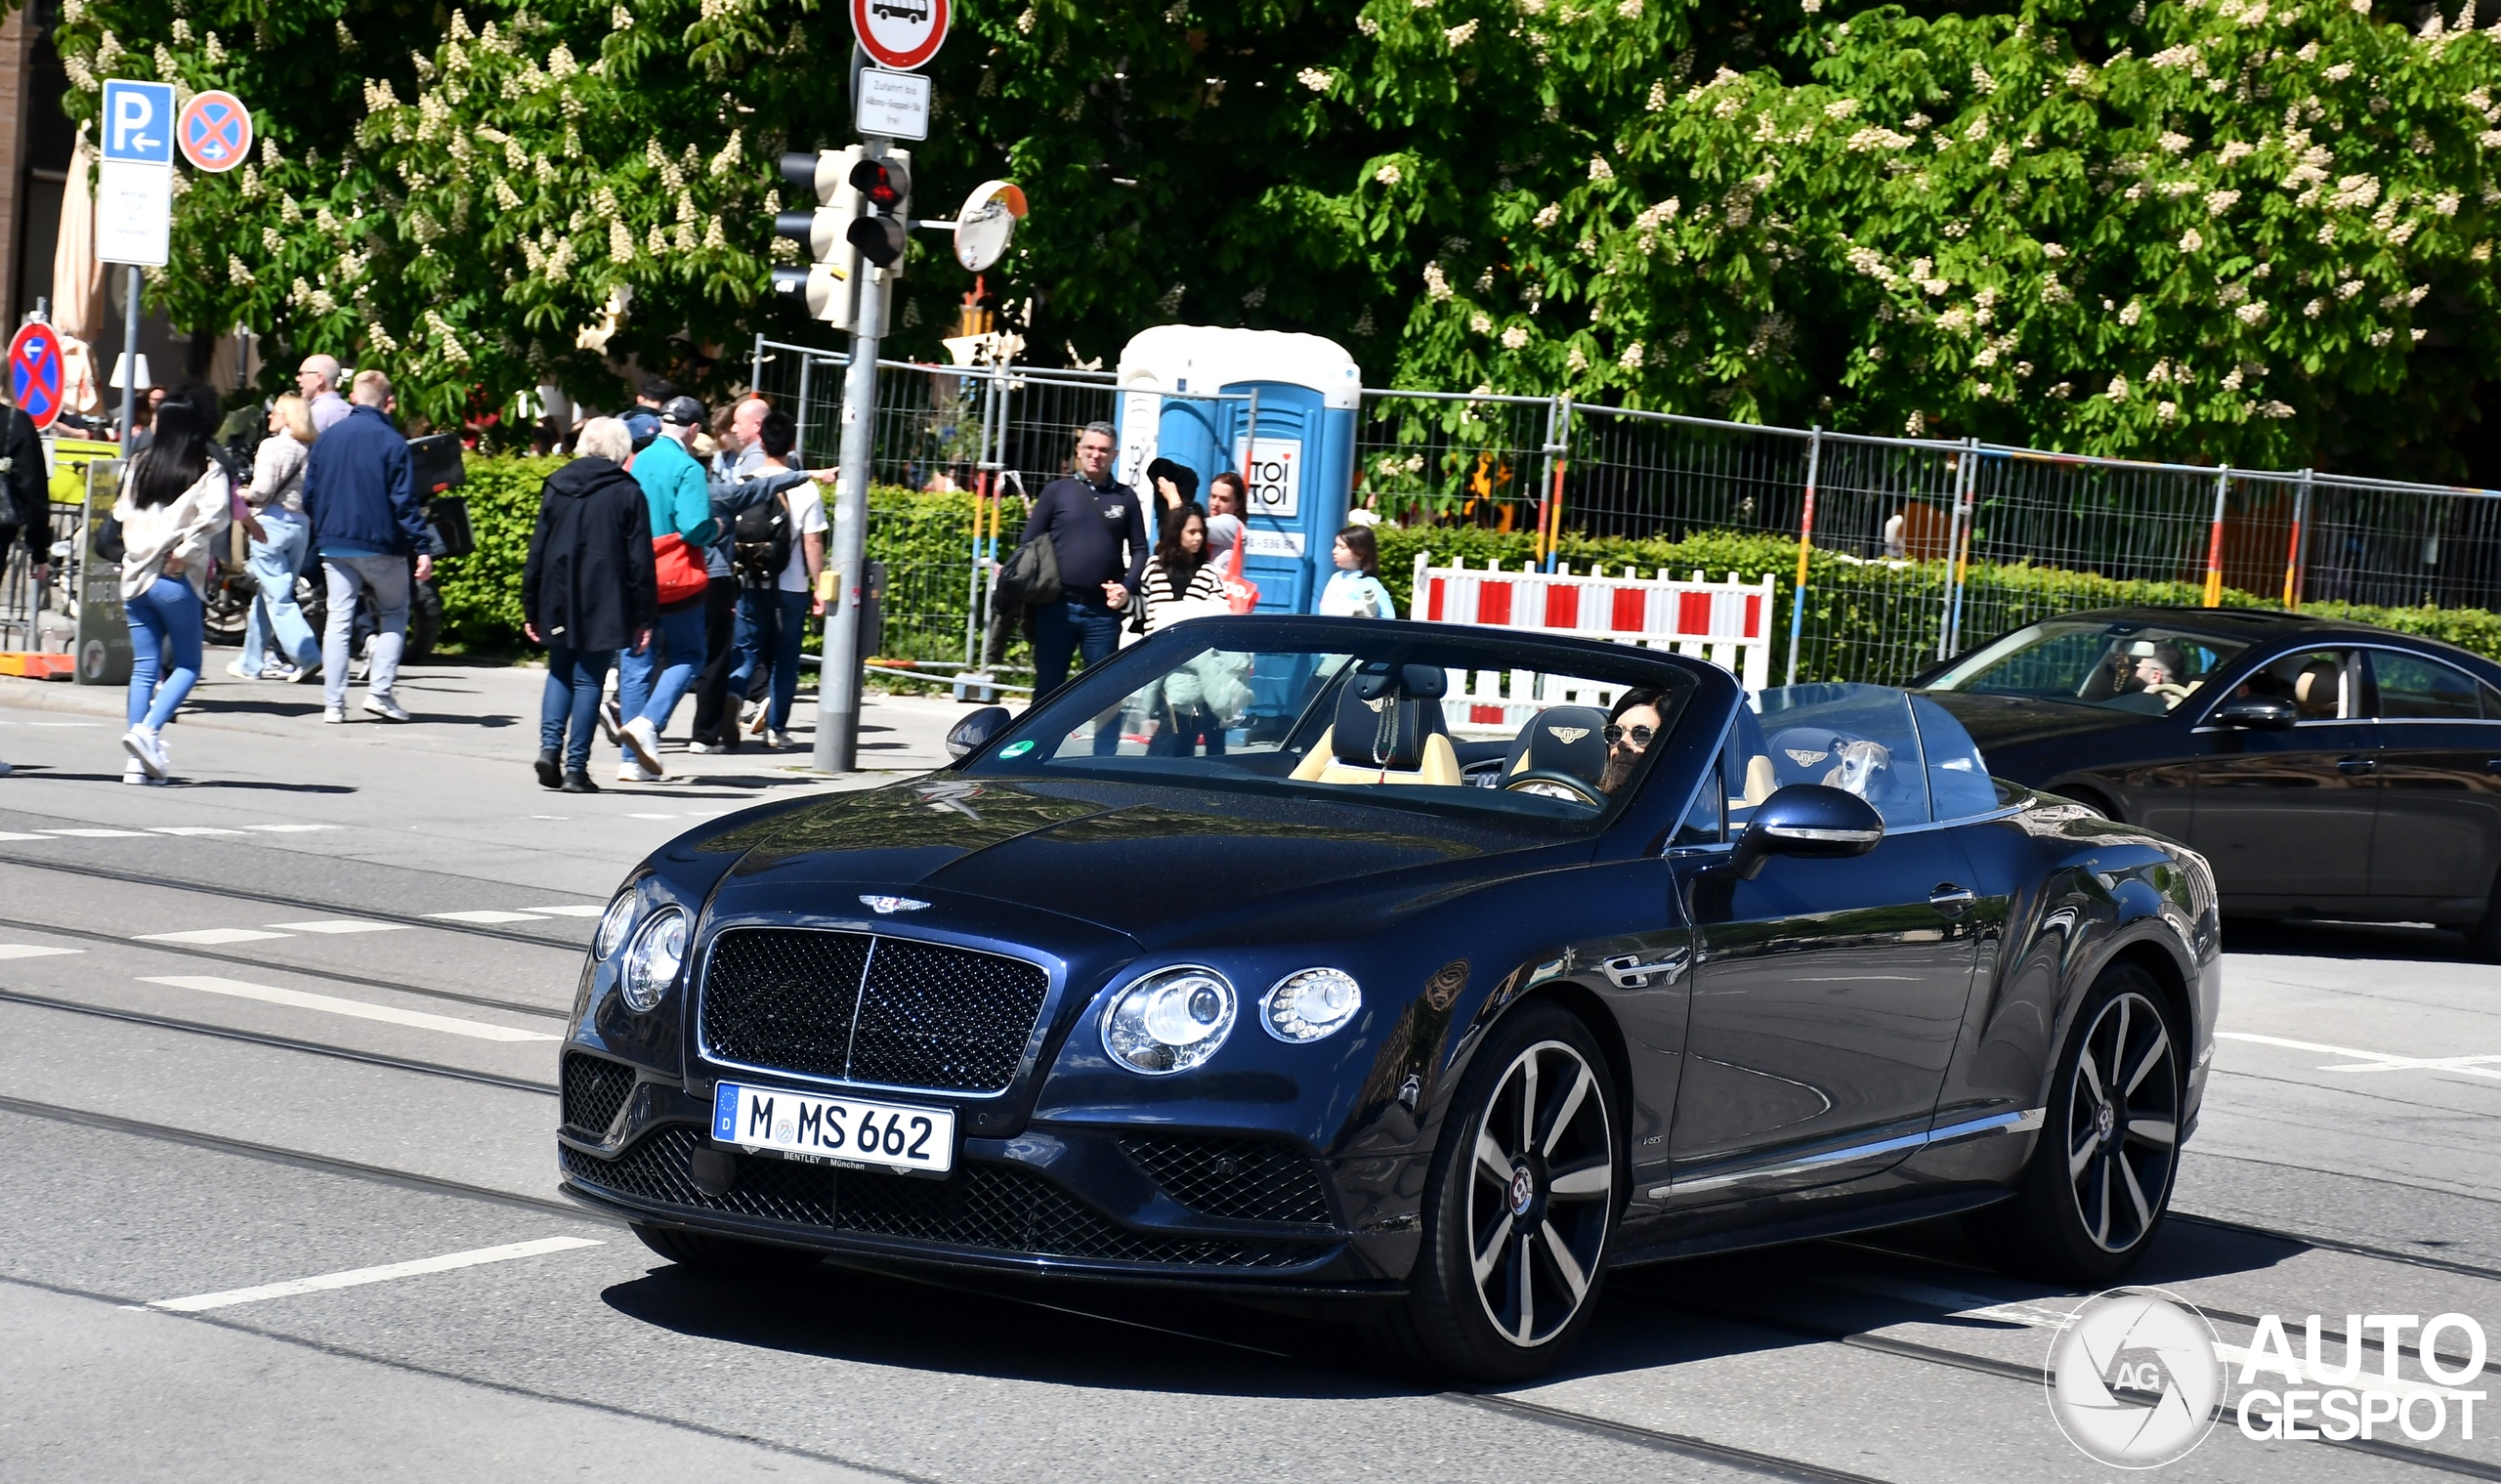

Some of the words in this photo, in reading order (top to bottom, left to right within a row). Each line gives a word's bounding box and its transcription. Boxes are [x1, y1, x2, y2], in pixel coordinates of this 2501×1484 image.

[113, 91, 152, 150] P
[722, 1117, 731, 1130] D
[749, 1094, 774, 1139] M
[797, 1101, 847, 1149] MS
[857, 1110, 933, 1161] 662
[784, 1152, 821, 1165] BENTLEY
[829, 1159, 866, 1170] München
